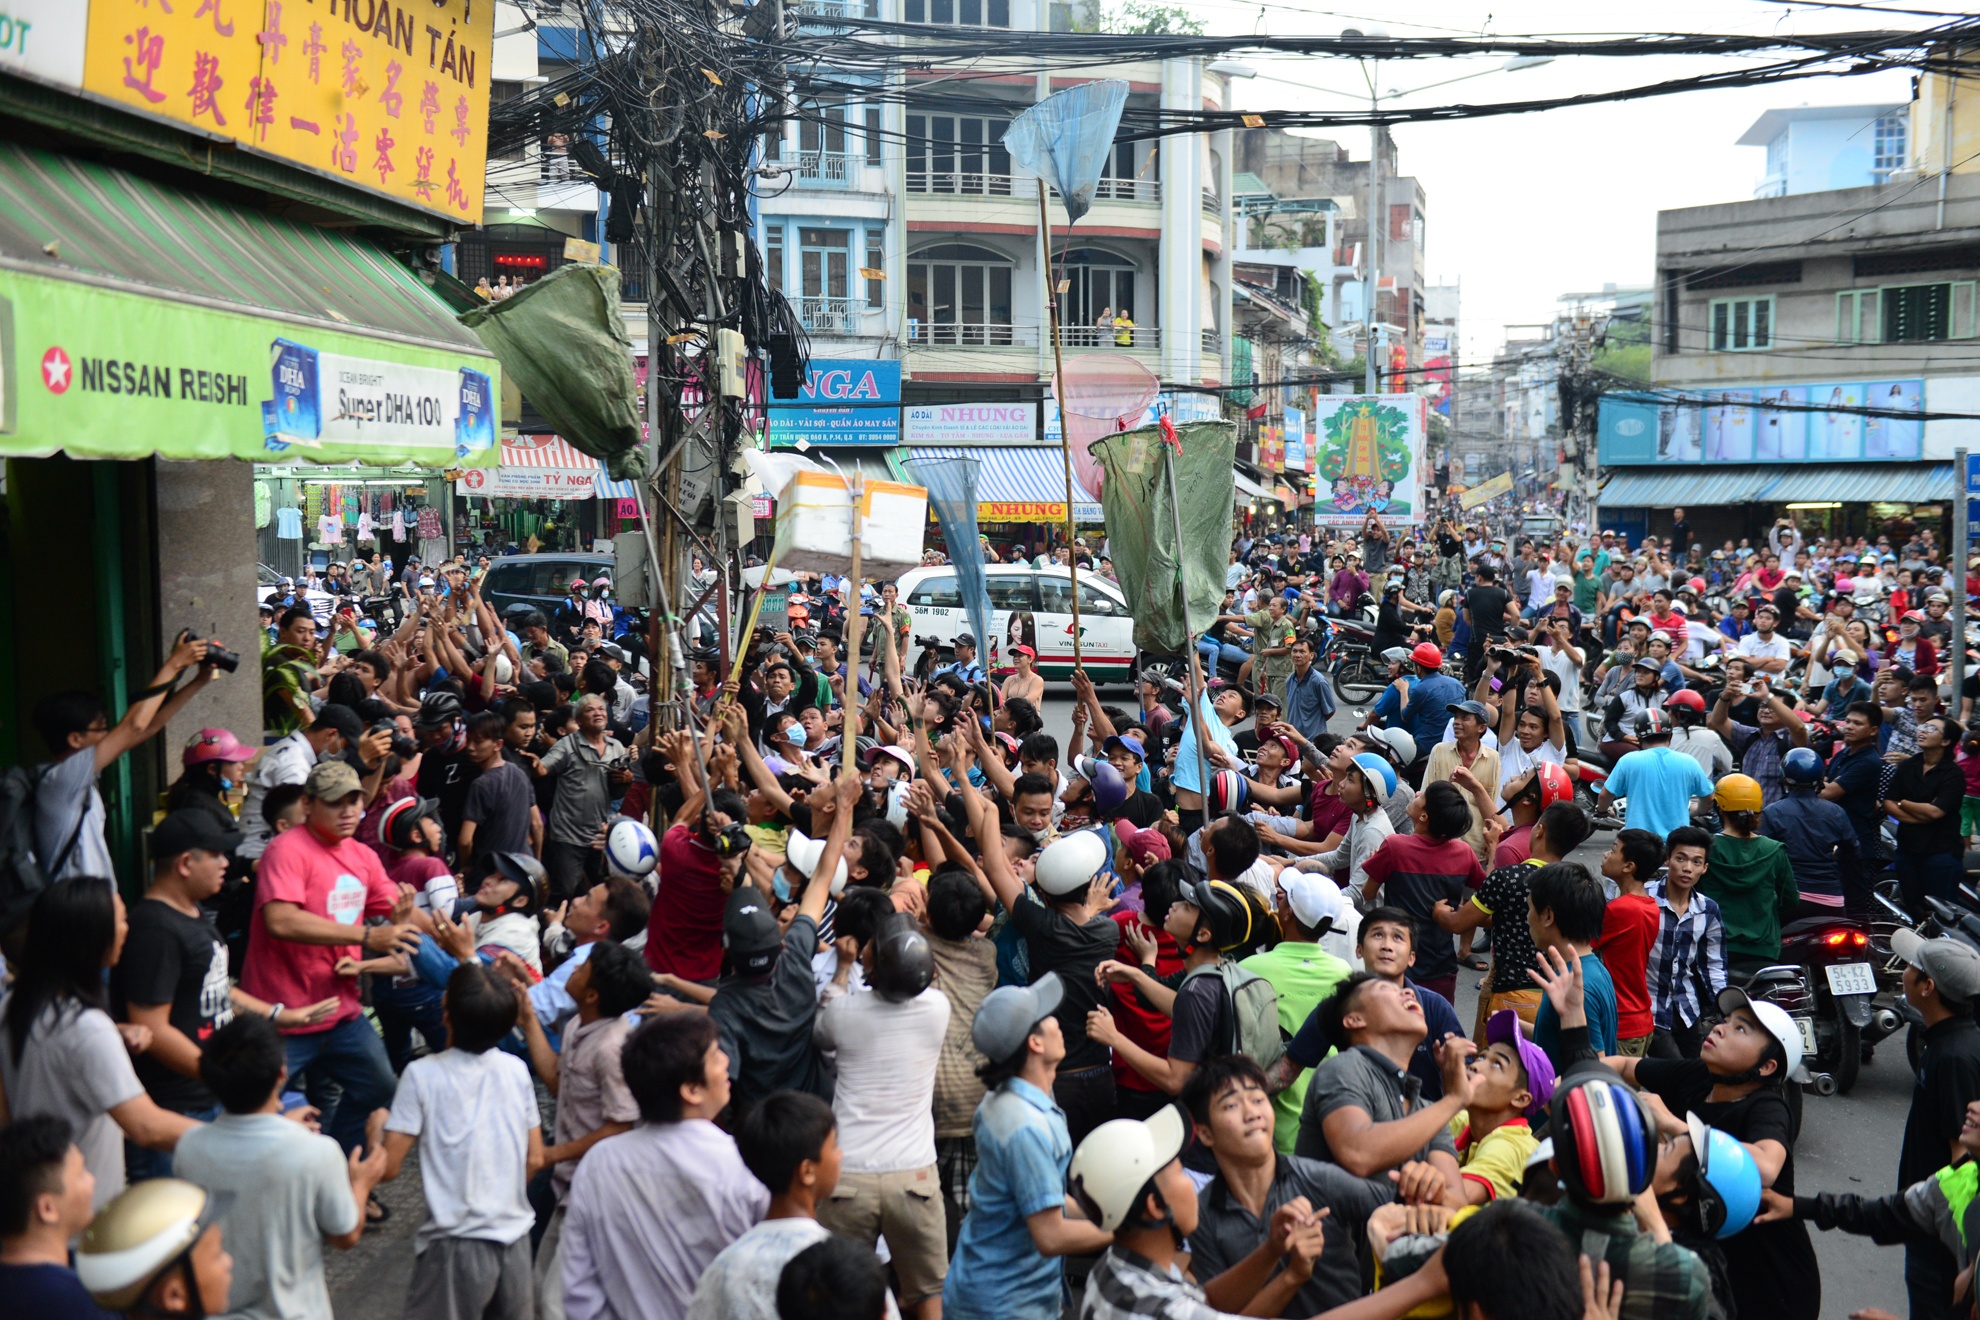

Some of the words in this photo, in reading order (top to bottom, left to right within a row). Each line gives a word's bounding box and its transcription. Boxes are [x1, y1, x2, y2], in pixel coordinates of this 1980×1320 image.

[426, 24, 475, 89] TÁN
[81, 356, 171, 399] NISSAN
[179, 367, 247, 406] REISHI
[279, 365, 305, 389] DHA
[461, 388, 482, 407] DHA
[338, 387, 382, 429] Super
[385, 392, 413, 425] DHA
[417, 396, 442, 427] 100
[910, 408, 920, 419] ÁO
[921, 408, 933, 419] DÀI
[940, 407, 1026, 422] NHUNG
[864, 419, 881, 427] MAY
[543, 471, 562, 485] TỶ
[566, 475, 592, 486] NGA
[990, 503, 1062, 516] NHUNG
[1082, 505, 1097, 515] HÀNG
[914, 606, 929, 615] 56M
[932, 607, 949, 616] 1902
[1832, 965, 1866, 980] 54-K2
[1836, 978, 1869, 992] 5933
